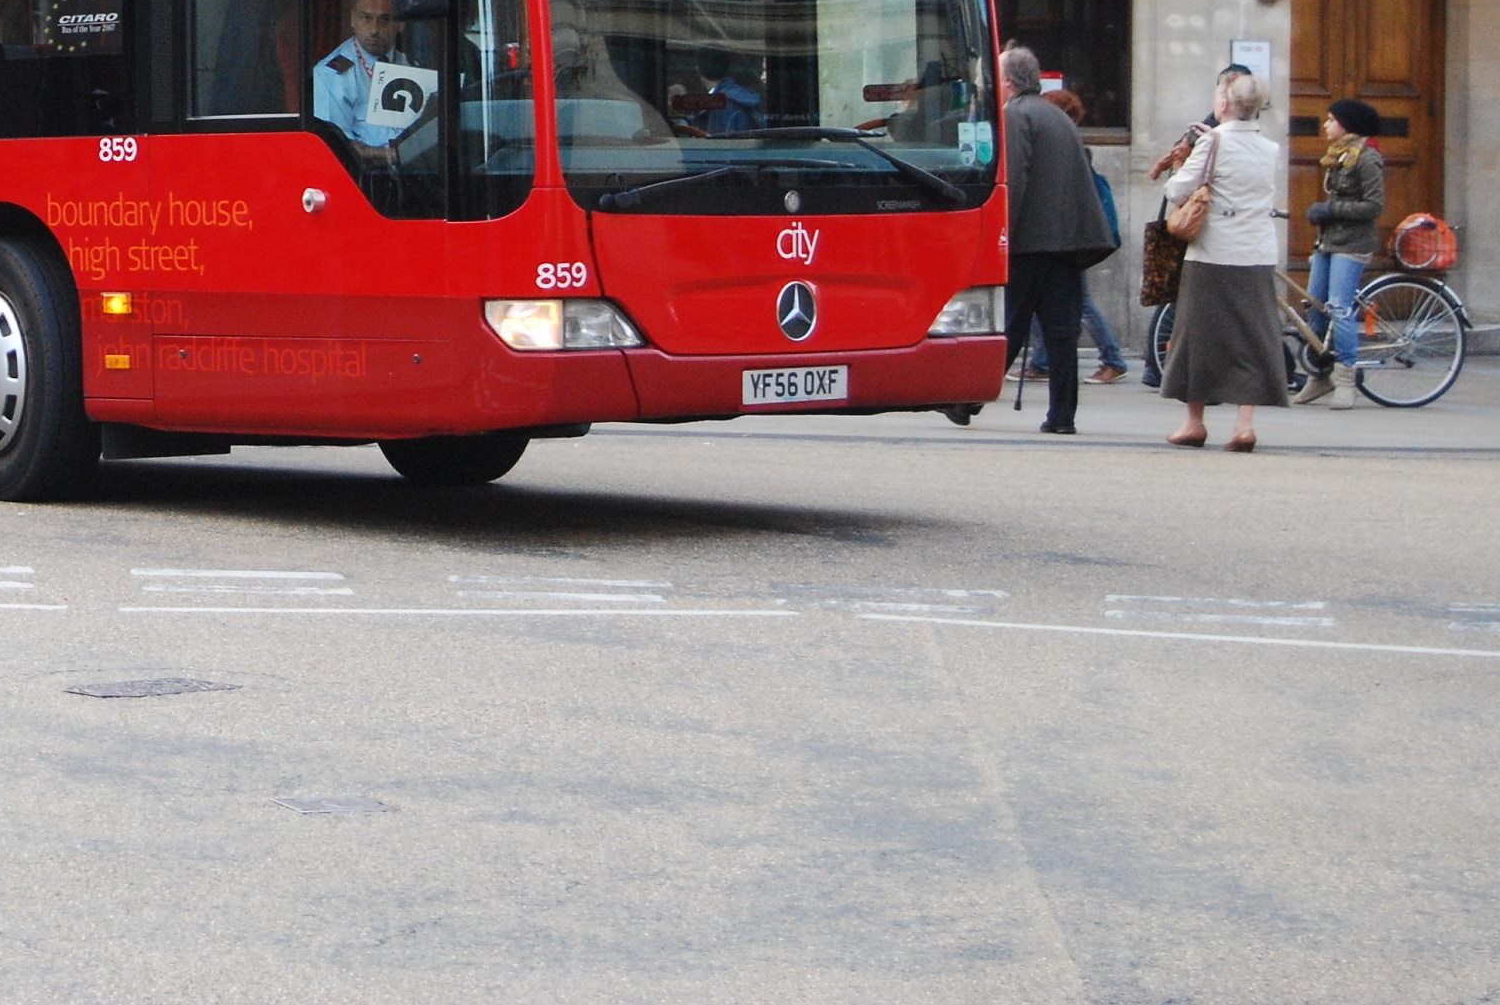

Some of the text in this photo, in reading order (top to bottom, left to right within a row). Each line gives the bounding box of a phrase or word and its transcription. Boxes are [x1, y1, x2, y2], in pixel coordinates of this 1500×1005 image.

[58, 12, 119, 24] CITARO
[381, 78, 424, 114] G
[99, 137, 138, 162] 859
[47, 191, 253, 235] boundary house,
[68, 237, 205, 281] high street,
[776, 221, 820, 265] city
[535, 261, 588, 290] 859
[82, 291, 189, 331] mston,
[159, 335, 253, 373] radcliffe
[263, 339, 367, 385] hospital
[749, 369, 840, 399] YF56 OXF
